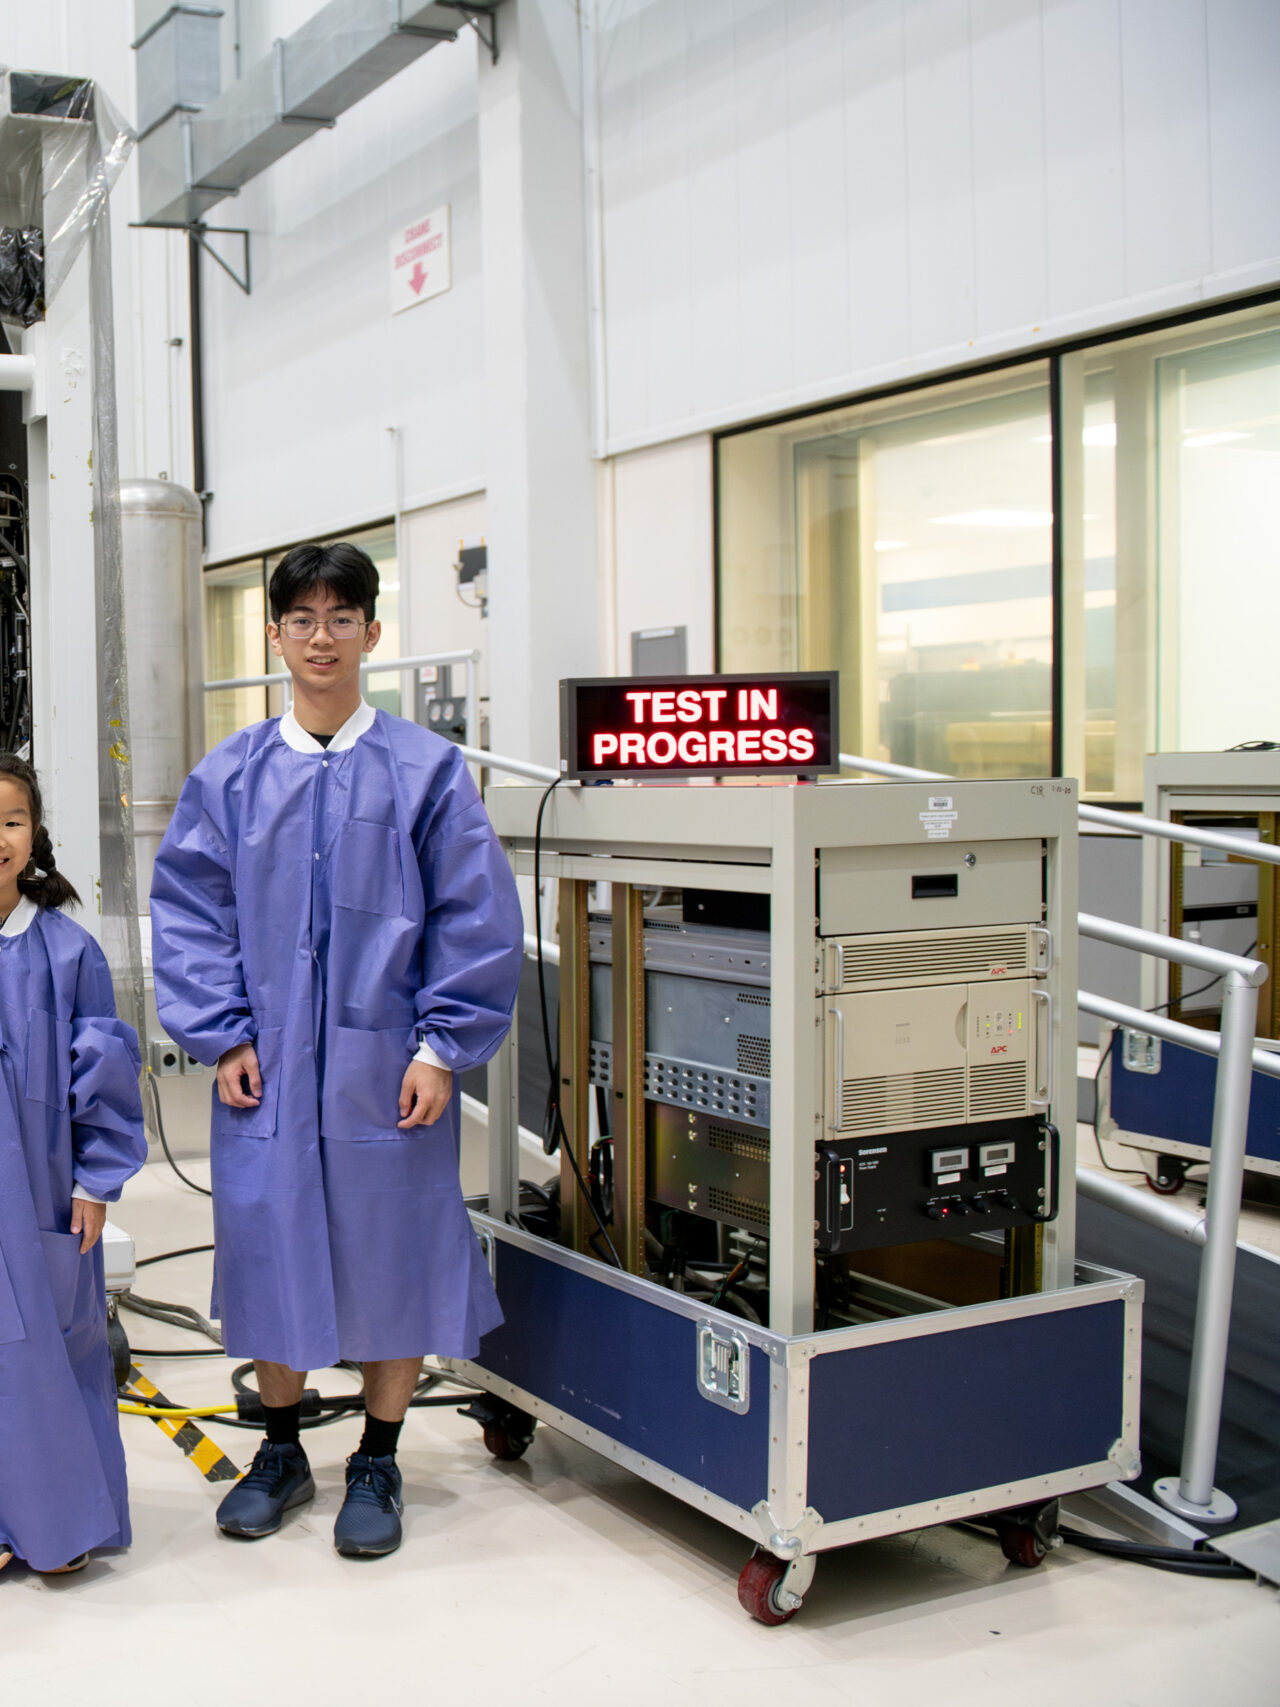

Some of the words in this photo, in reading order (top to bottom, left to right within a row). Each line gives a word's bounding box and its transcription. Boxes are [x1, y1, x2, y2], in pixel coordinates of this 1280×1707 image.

[626, 690, 727, 723] TEST
[738, 689, 778, 721] IN
[593, 728, 815, 765] PROGRESS
[991, 967, 1007, 976] APC
[990, 1045, 1008, 1055] APC
